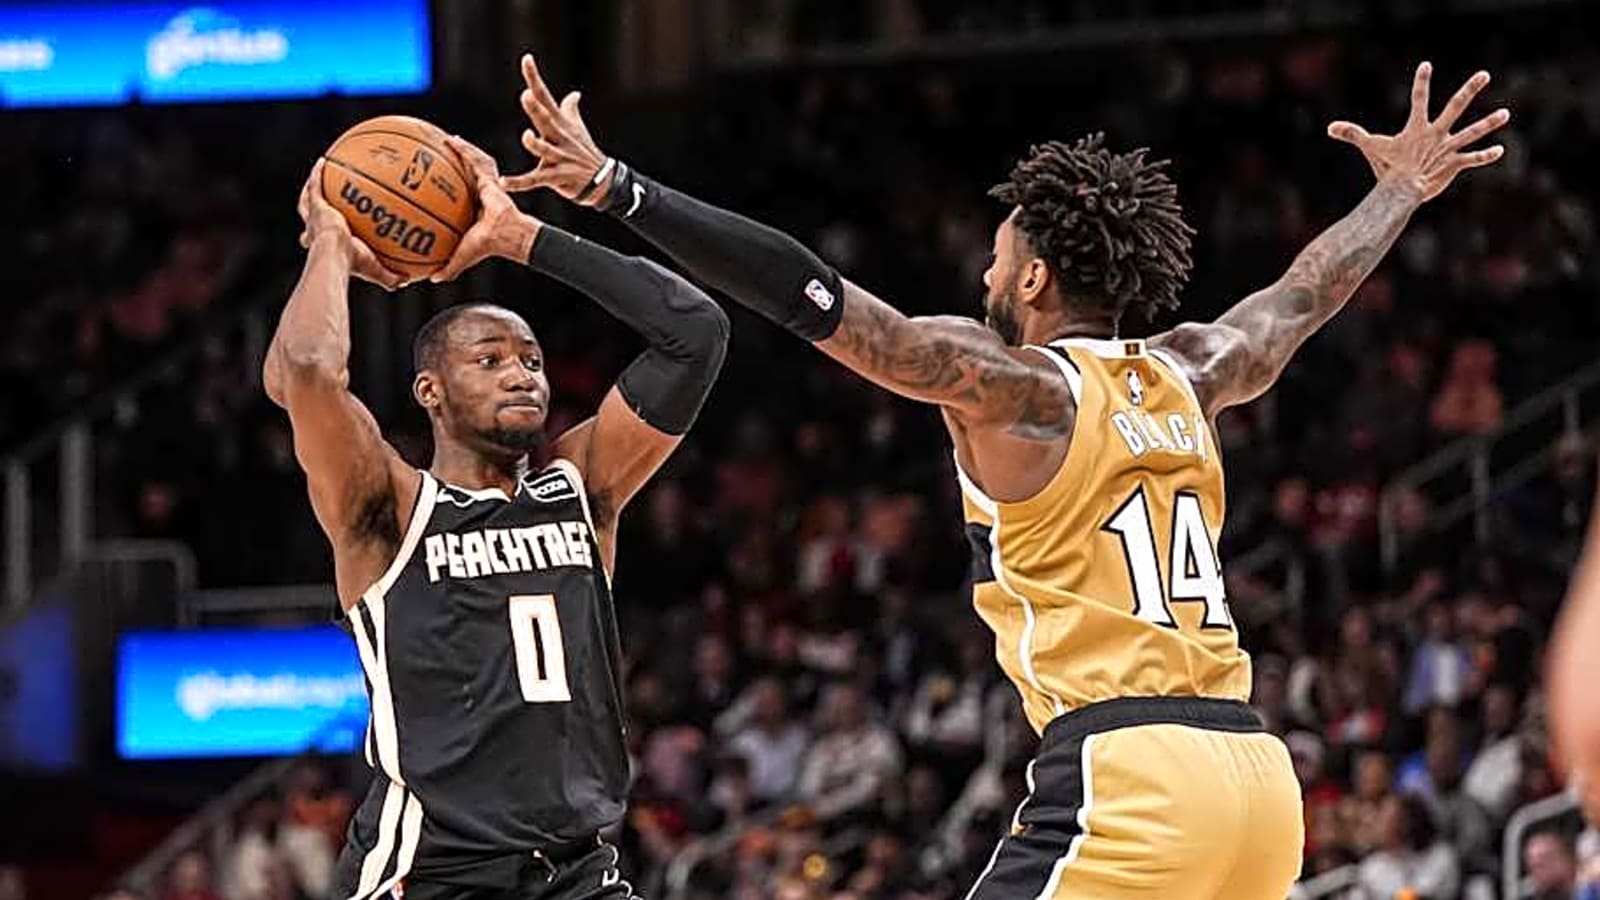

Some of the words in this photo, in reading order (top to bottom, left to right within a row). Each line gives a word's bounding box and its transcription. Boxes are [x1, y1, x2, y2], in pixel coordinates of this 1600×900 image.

[340, 180, 436, 256] Wilson
[424, 520, 593, 583] PEACHTREE
[1100, 484, 1234, 631] 14
[508, 594, 572, 702] 0
